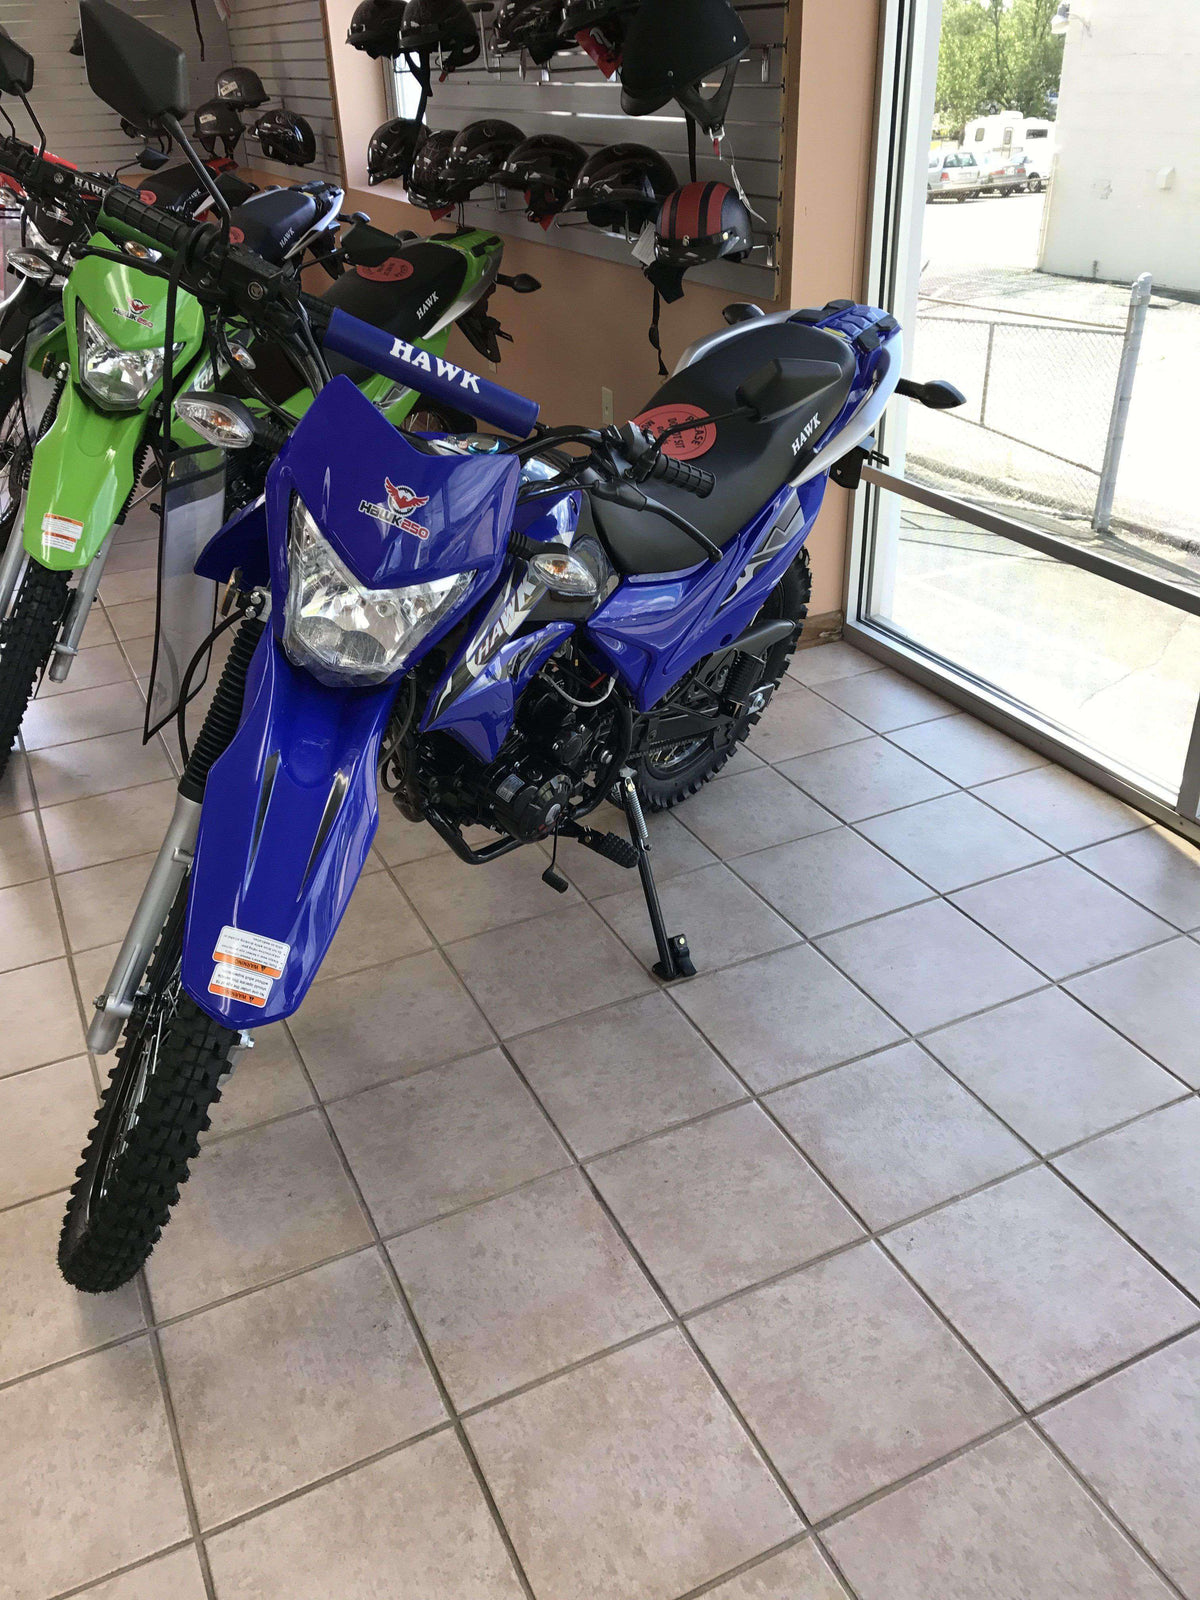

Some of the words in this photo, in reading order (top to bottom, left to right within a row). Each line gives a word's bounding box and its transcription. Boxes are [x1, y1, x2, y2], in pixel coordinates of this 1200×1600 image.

[416, 291, 439, 320] HAWK
[389, 337, 480, 394] HAWK
[685, 415, 704, 446] PASE
[791, 411, 821, 457] HAWK
[476, 573, 536, 666] HAWK
